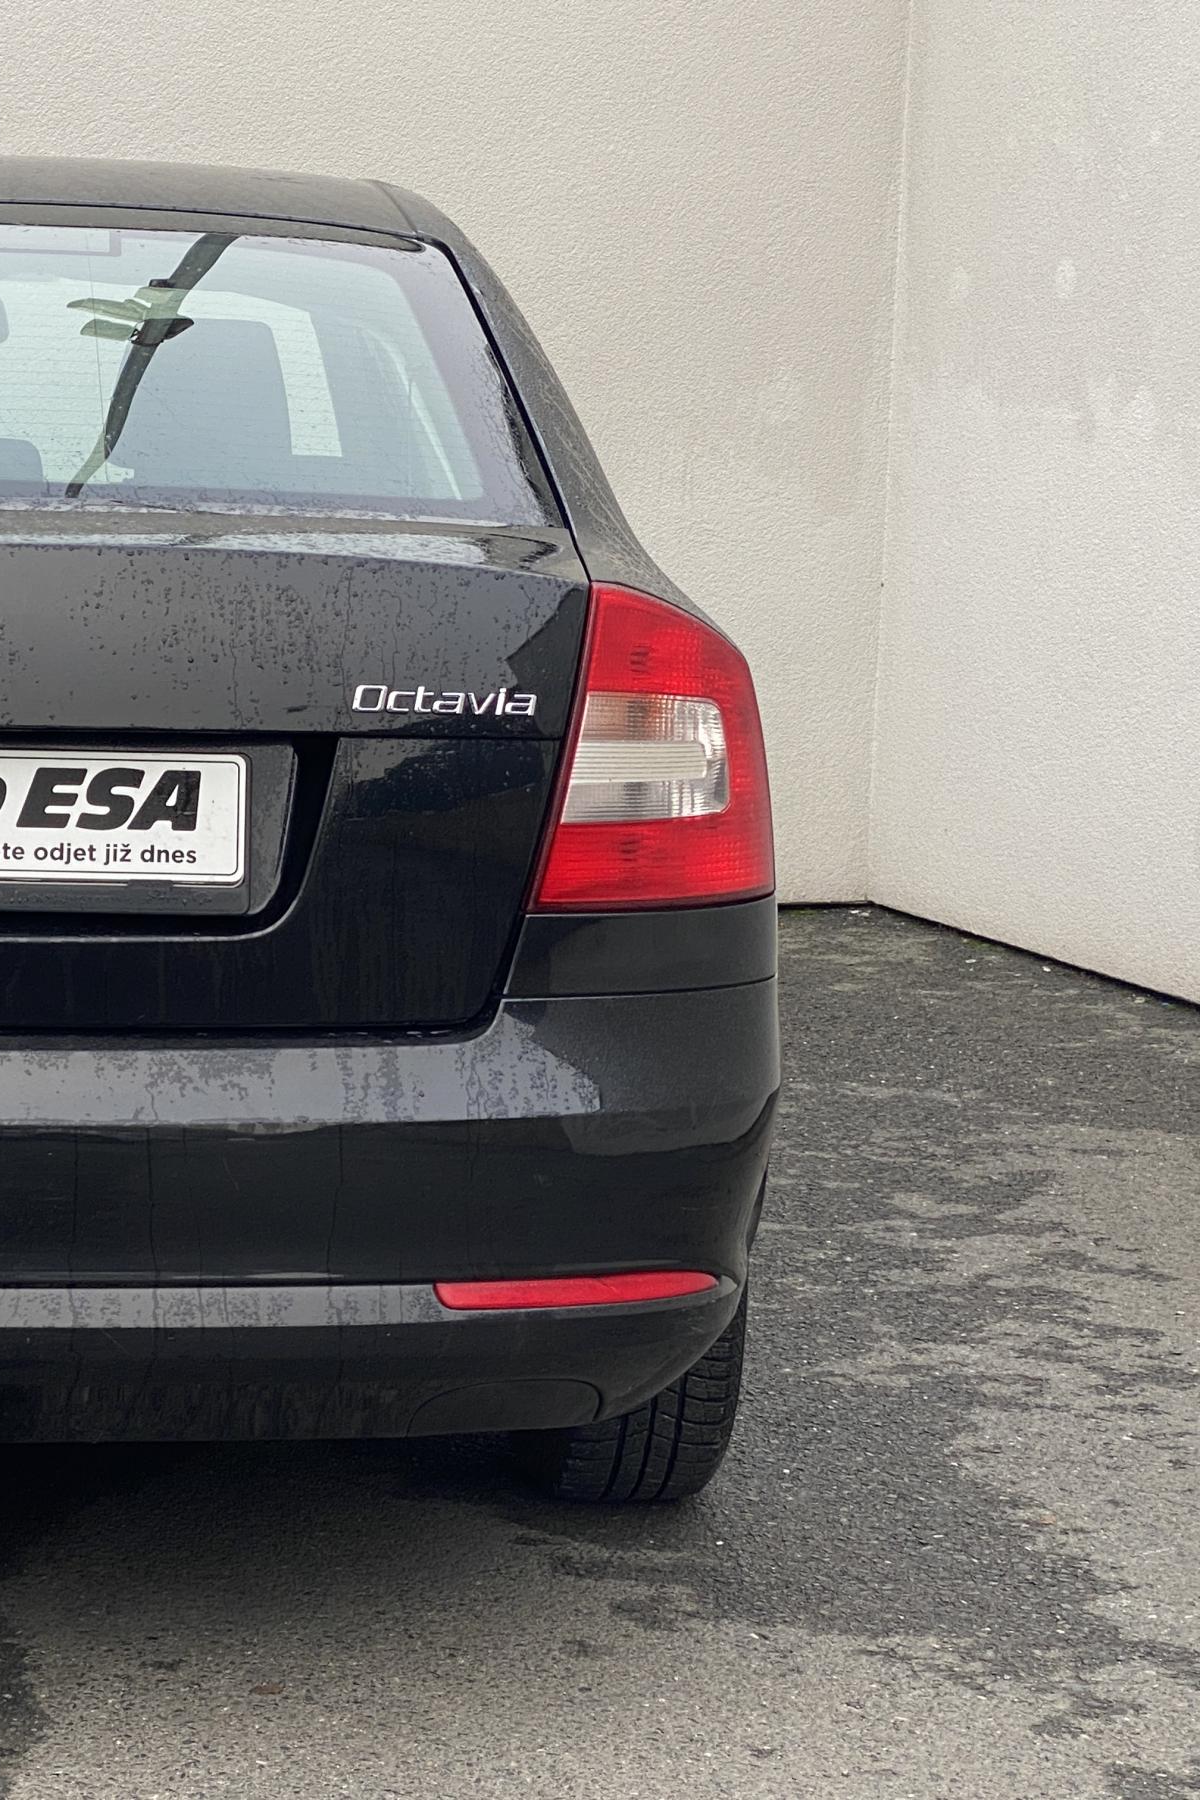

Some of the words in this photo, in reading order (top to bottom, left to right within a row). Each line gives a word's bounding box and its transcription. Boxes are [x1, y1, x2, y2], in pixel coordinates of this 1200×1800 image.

[352, 685, 537, 716] Octavia
[16, 767, 202, 832] ESA
[33, 843, 97, 865] odjet
[103, 843, 132, 866] již
[140, 844, 197, 864] dnes
